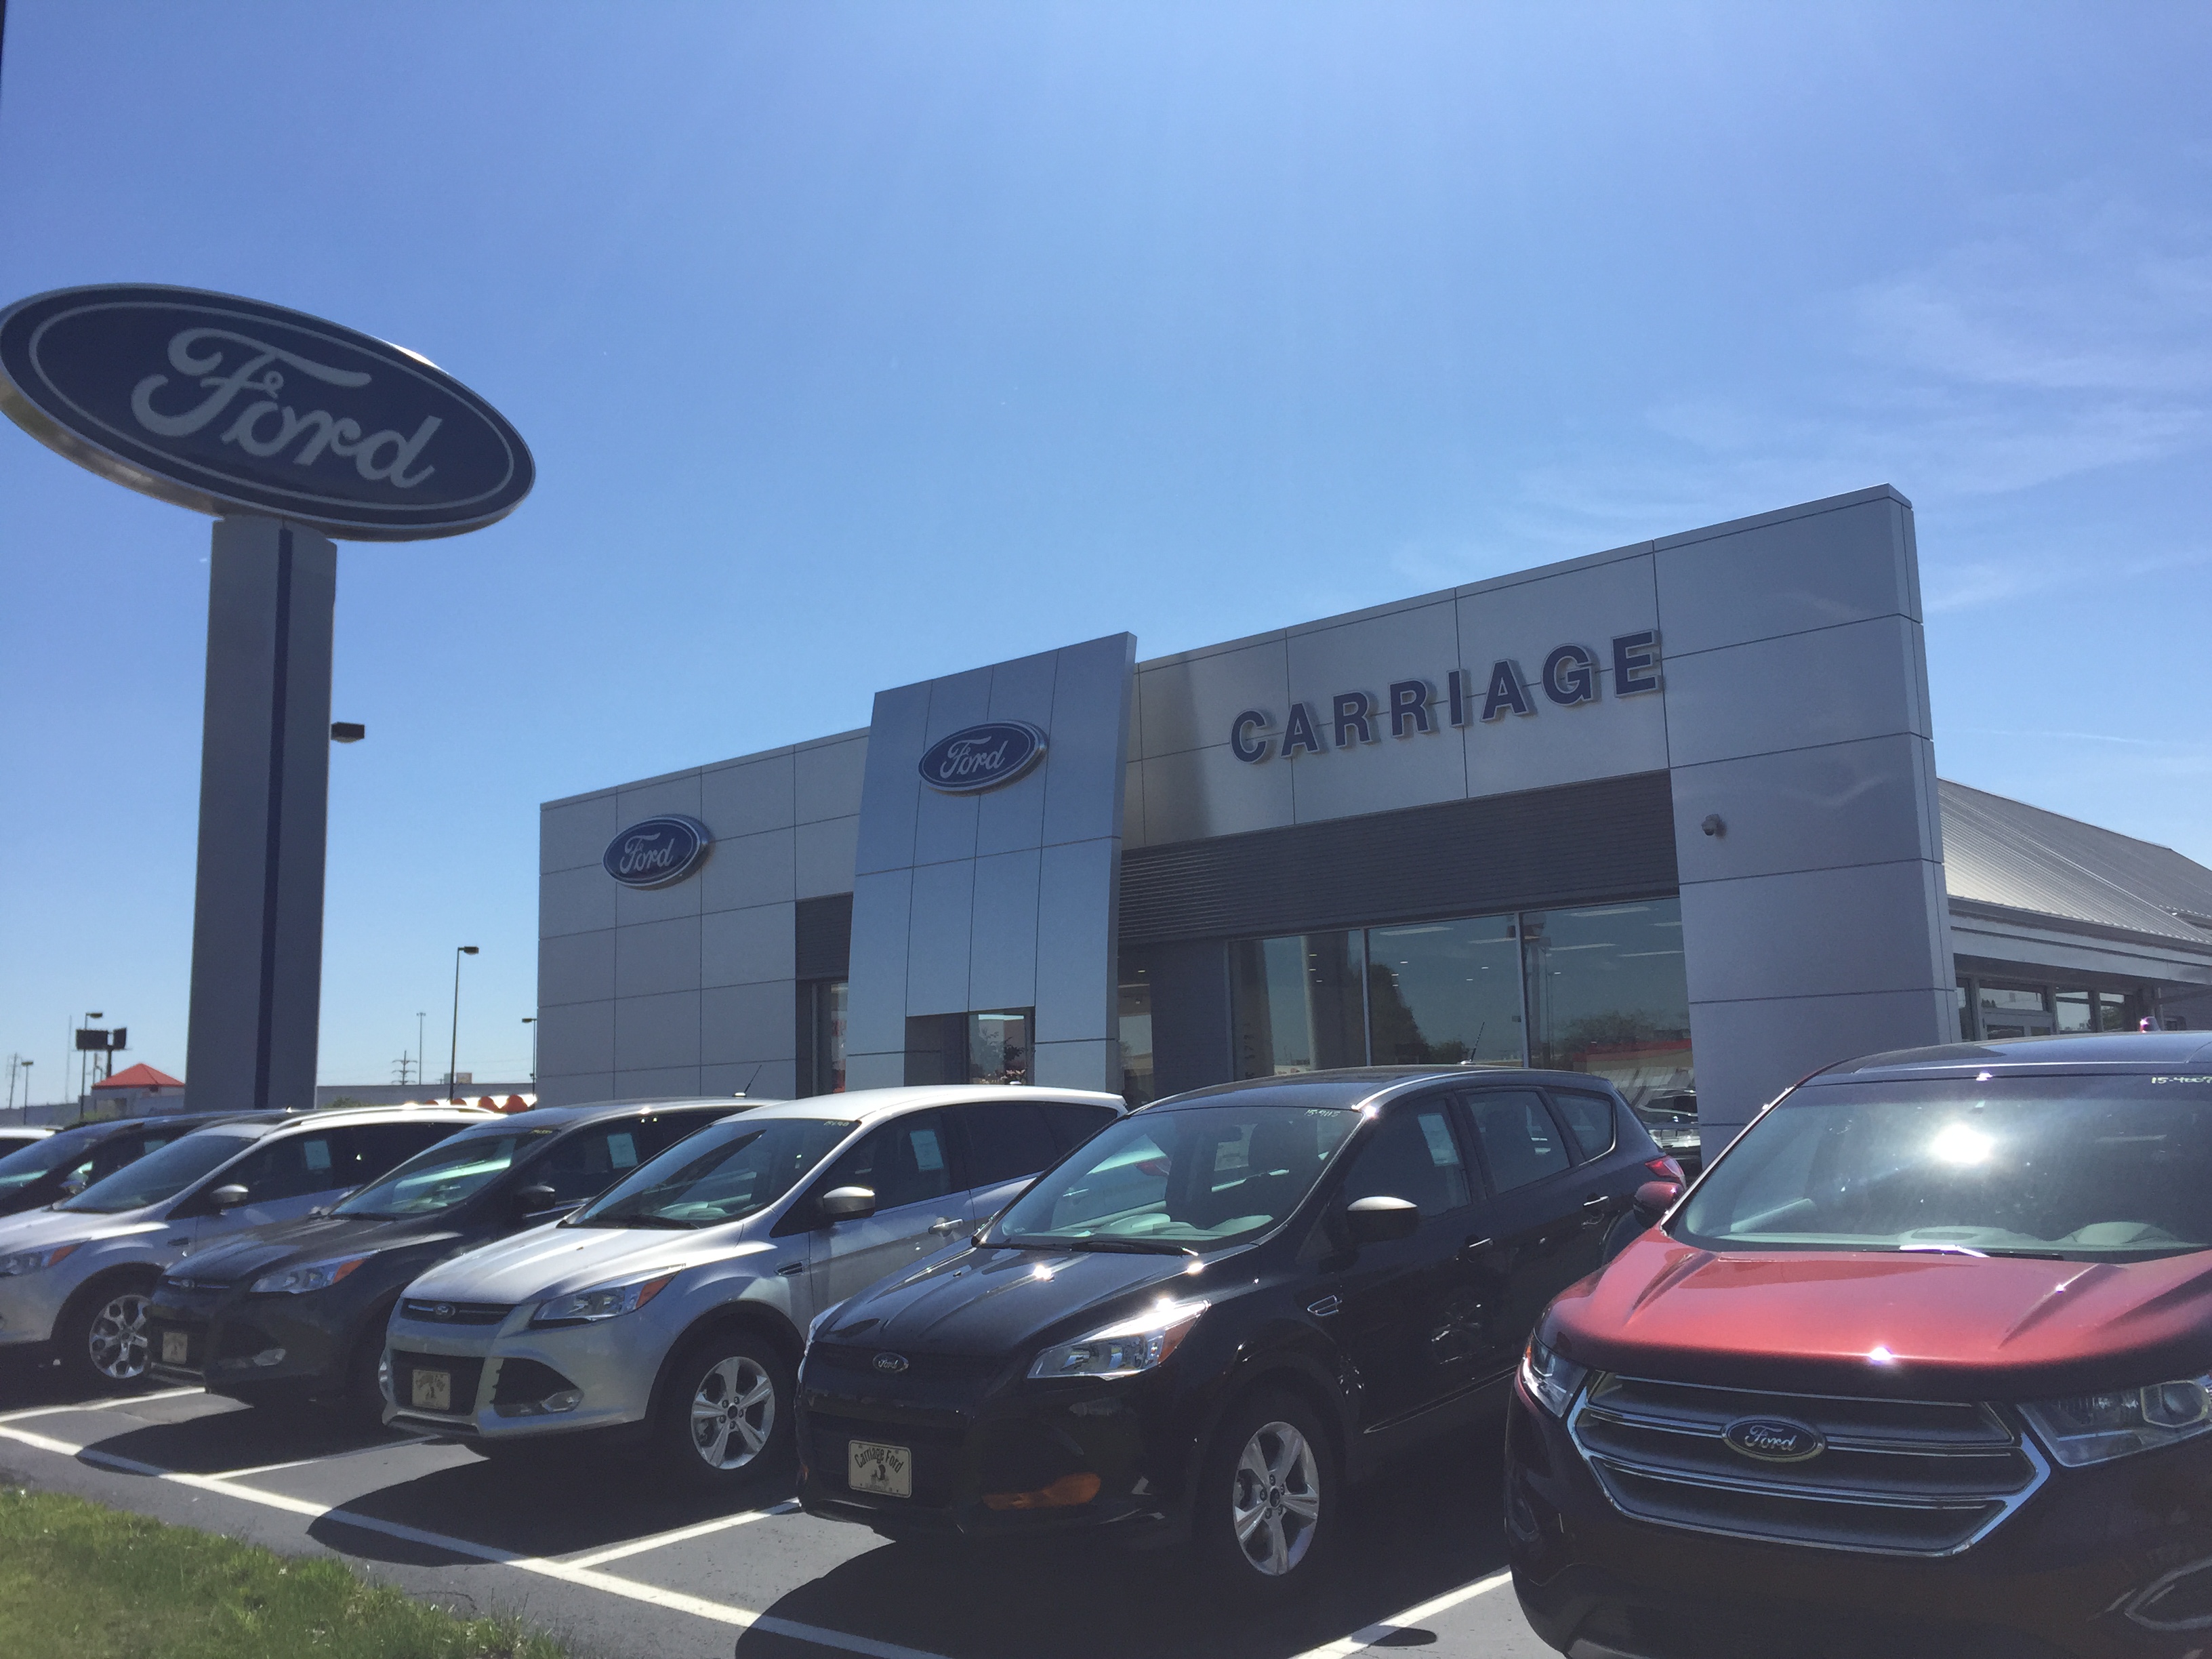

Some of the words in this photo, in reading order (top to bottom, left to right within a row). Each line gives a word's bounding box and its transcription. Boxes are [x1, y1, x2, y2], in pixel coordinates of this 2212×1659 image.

[131, 327, 443, 488] Ford
[1230, 629, 1662, 764] CARRIAGE
[940, 736, 1008, 779] Ford
[619, 832, 675, 874] Ford
[1744, 1425, 1797, 1451] Ford
[854, 1447, 884, 1469] Carriage
[886, 1450, 904, 1473] Ford
